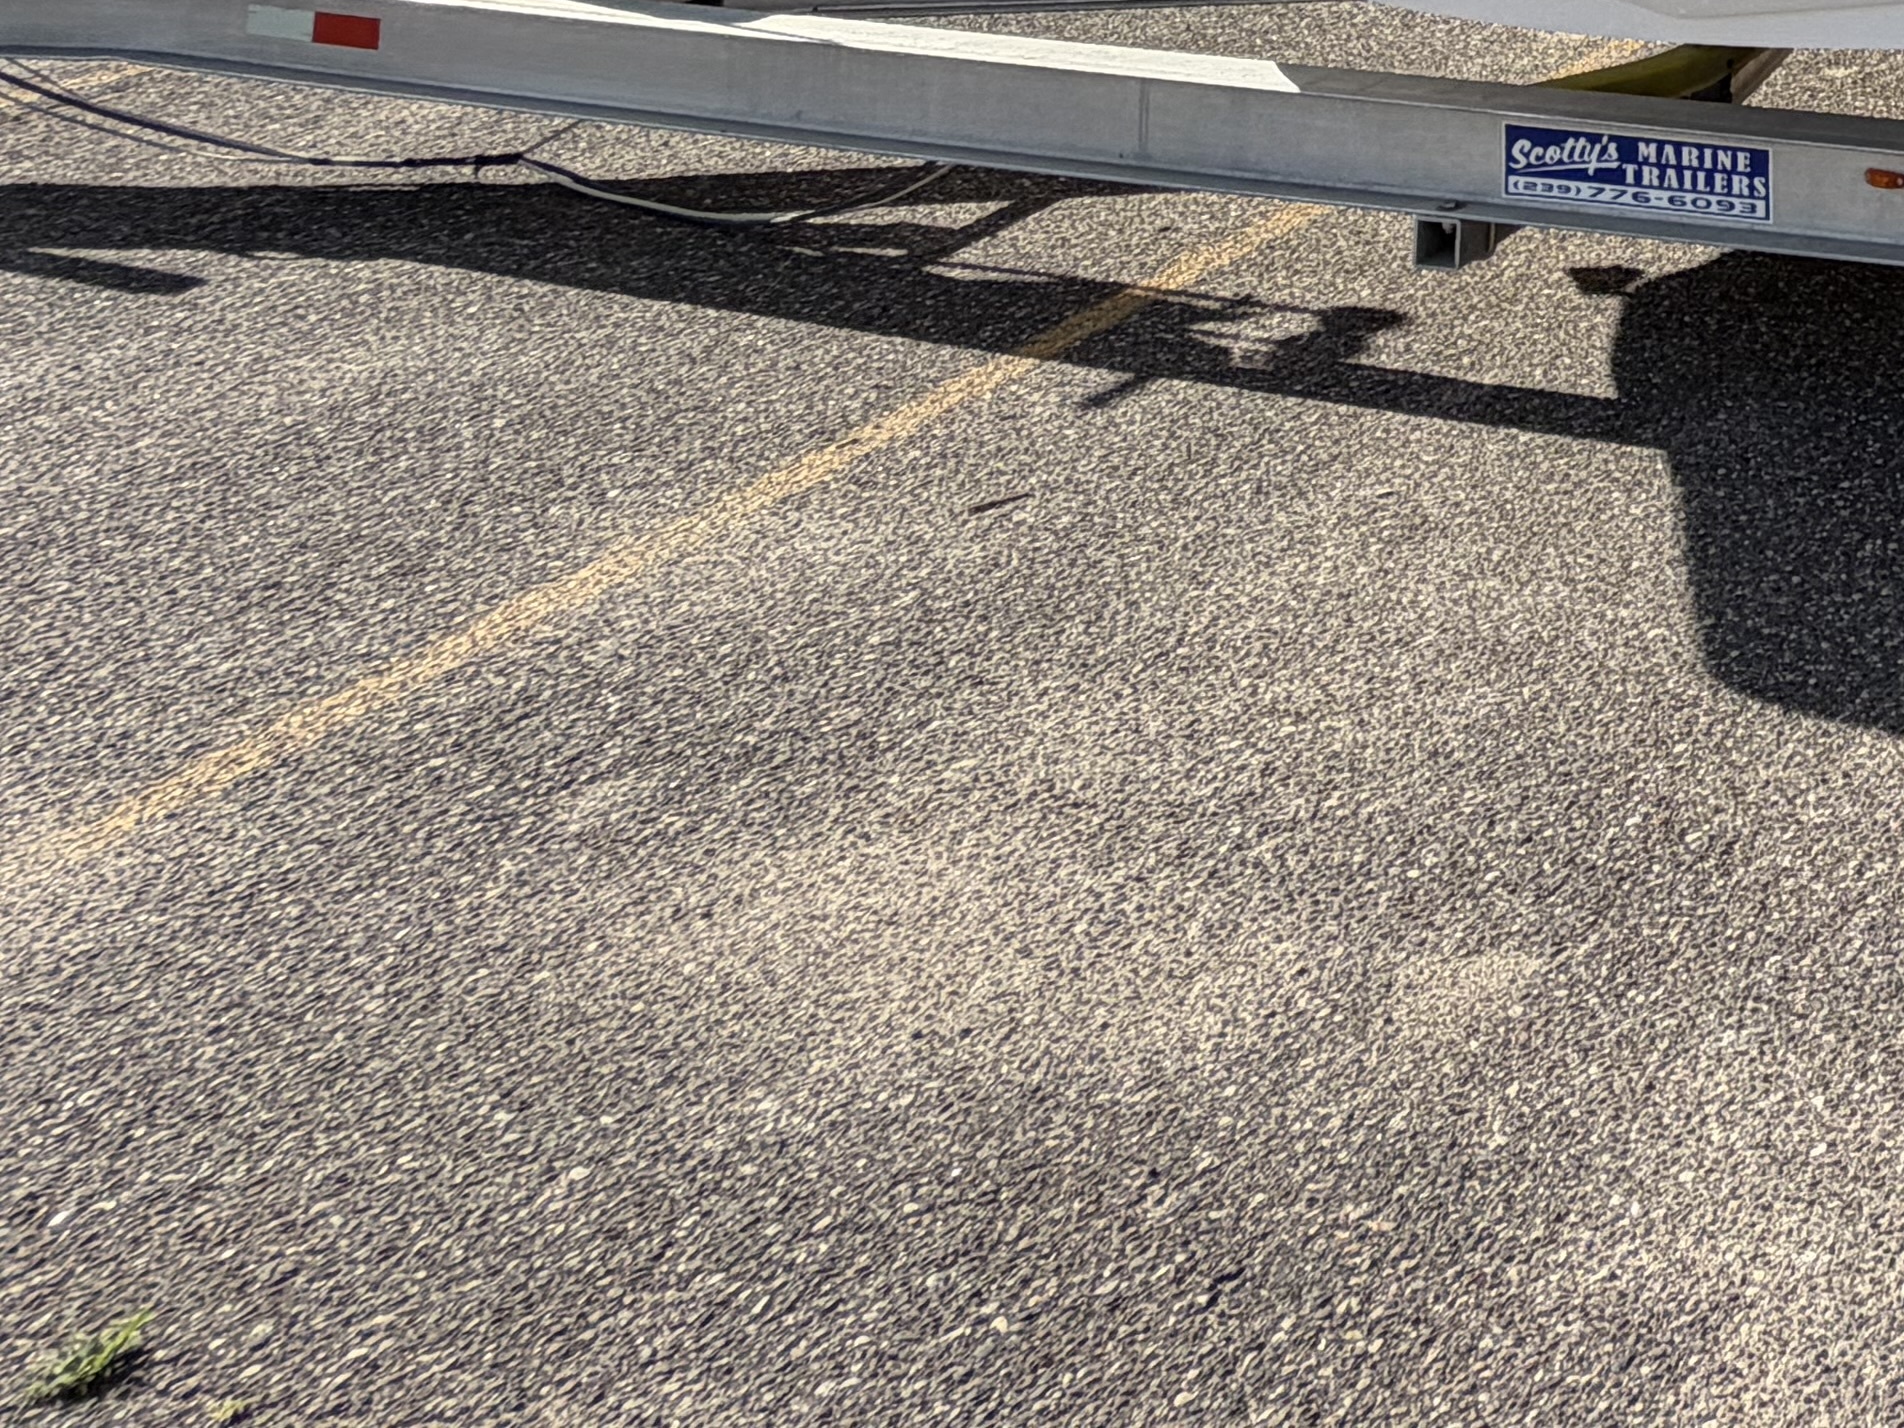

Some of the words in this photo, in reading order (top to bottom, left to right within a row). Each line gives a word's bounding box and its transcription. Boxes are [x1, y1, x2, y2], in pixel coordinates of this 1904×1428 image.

[1508, 134, 1621, 176] Scotty's
[1637, 141, 1752, 173] MARINE
[1621, 163, 1767, 198] TRAILERS
